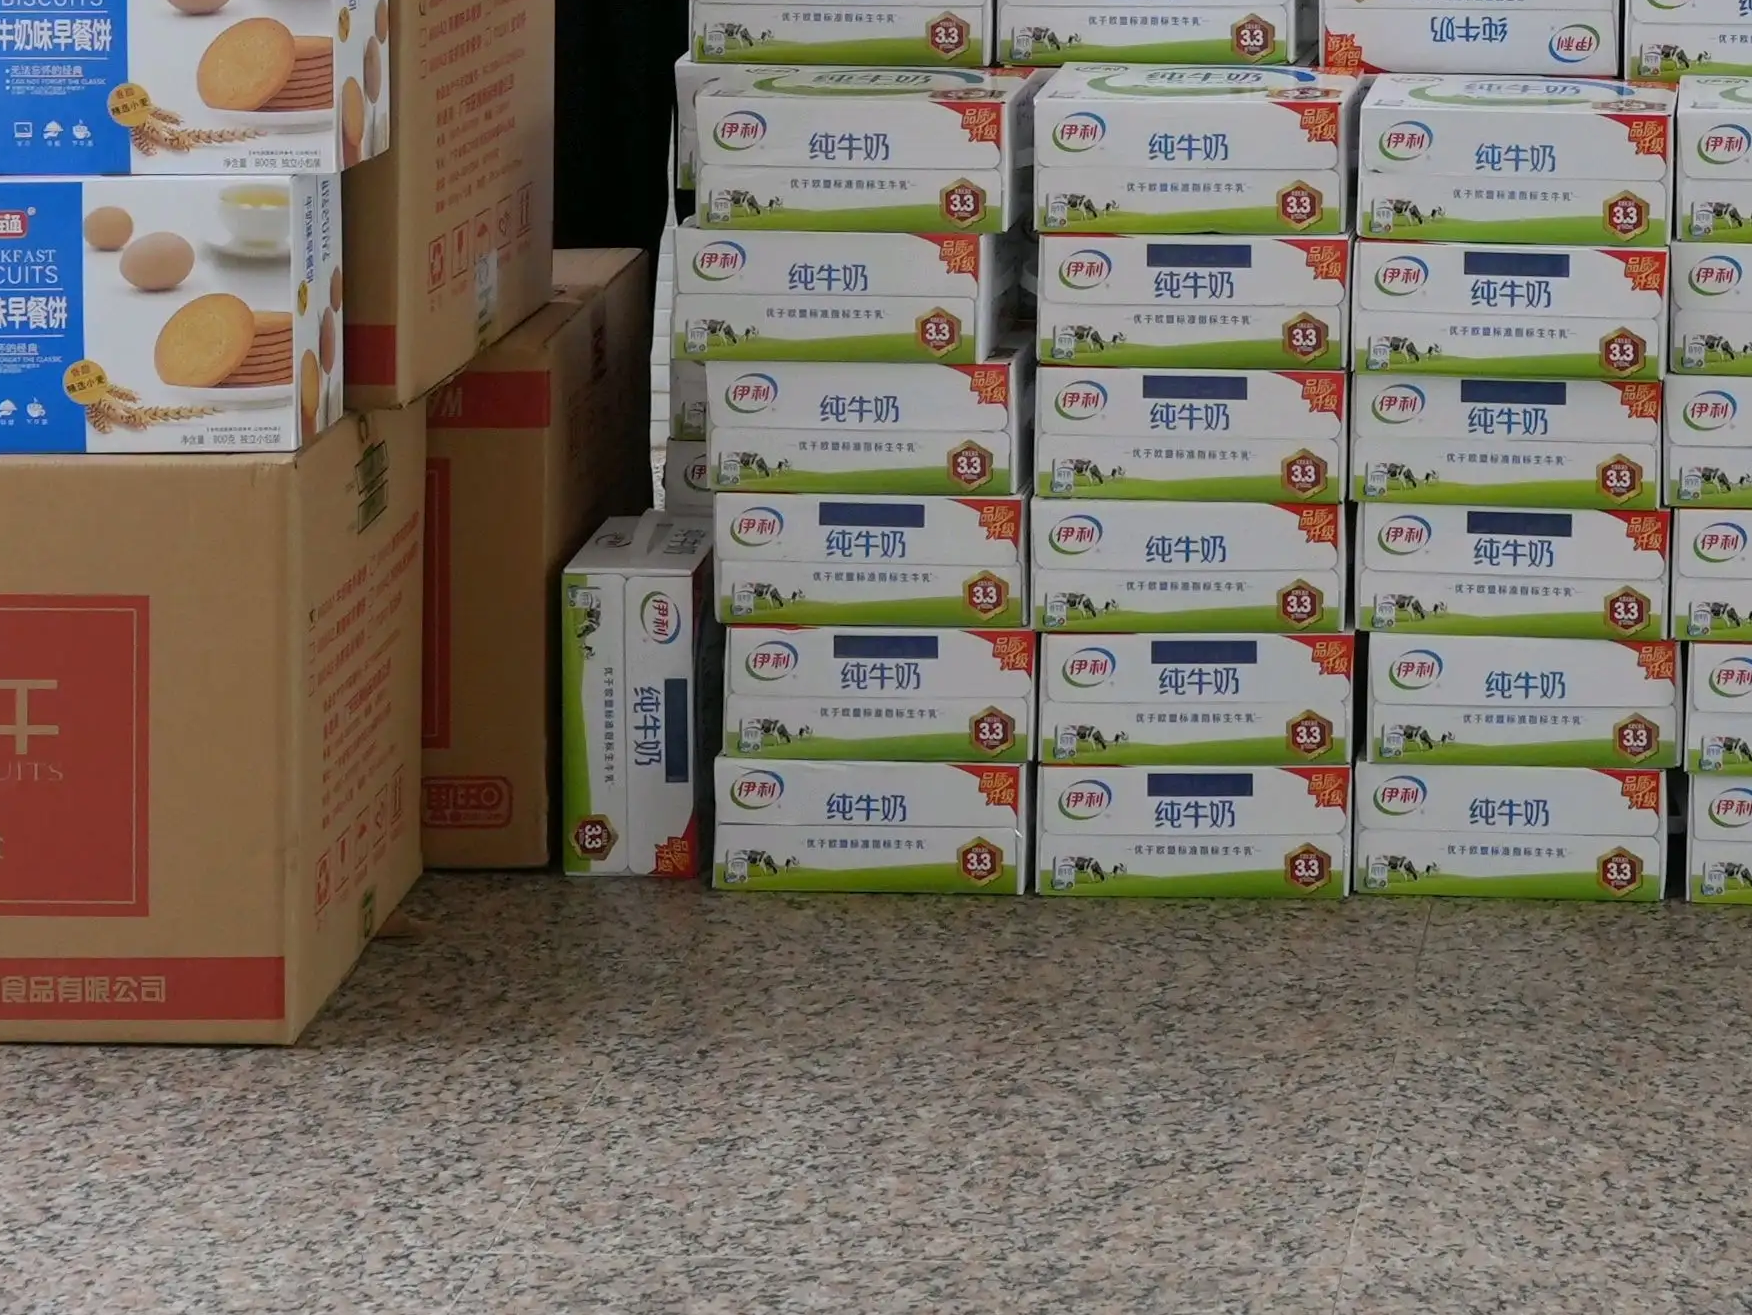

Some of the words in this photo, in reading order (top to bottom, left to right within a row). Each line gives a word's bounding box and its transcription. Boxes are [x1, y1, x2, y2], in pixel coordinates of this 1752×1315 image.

[1240, 29, 1263, 46] 3.3
[1429, 15, 1507, 42] 纯牛奶
[1061, 123, 1098, 140] 伊利
[1706, 136, 1743, 153] 伊利
[810, 133, 890, 162] 纯牛奶
[1148, 134, 1228, 163] 纯牛奶
[1476, 145, 1556, 174] 纯牛奶
[1613, 206, 1637, 224] 3.3
[694, 252, 734, 269] 伊利
[788, 264, 869, 293] 纯牛奶
[1155, 272, 1234, 299] 纯牛奶
[820, 396, 899, 425] 纯牛奶
[1291, 464, 1315, 482] 3.3
[1146, 536, 1227, 565] 纯牛奶
[1473, 539, 1555, 568] 纯牛奶
[1159, 668, 1239, 697] 纯牛奶
[633, 685, 662, 767] 纯牛奶
[738, 782, 776, 798] 伊利
[827, 794, 907, 821] 纯牛奶
[1295, 859, 1319, 876] 3.3
